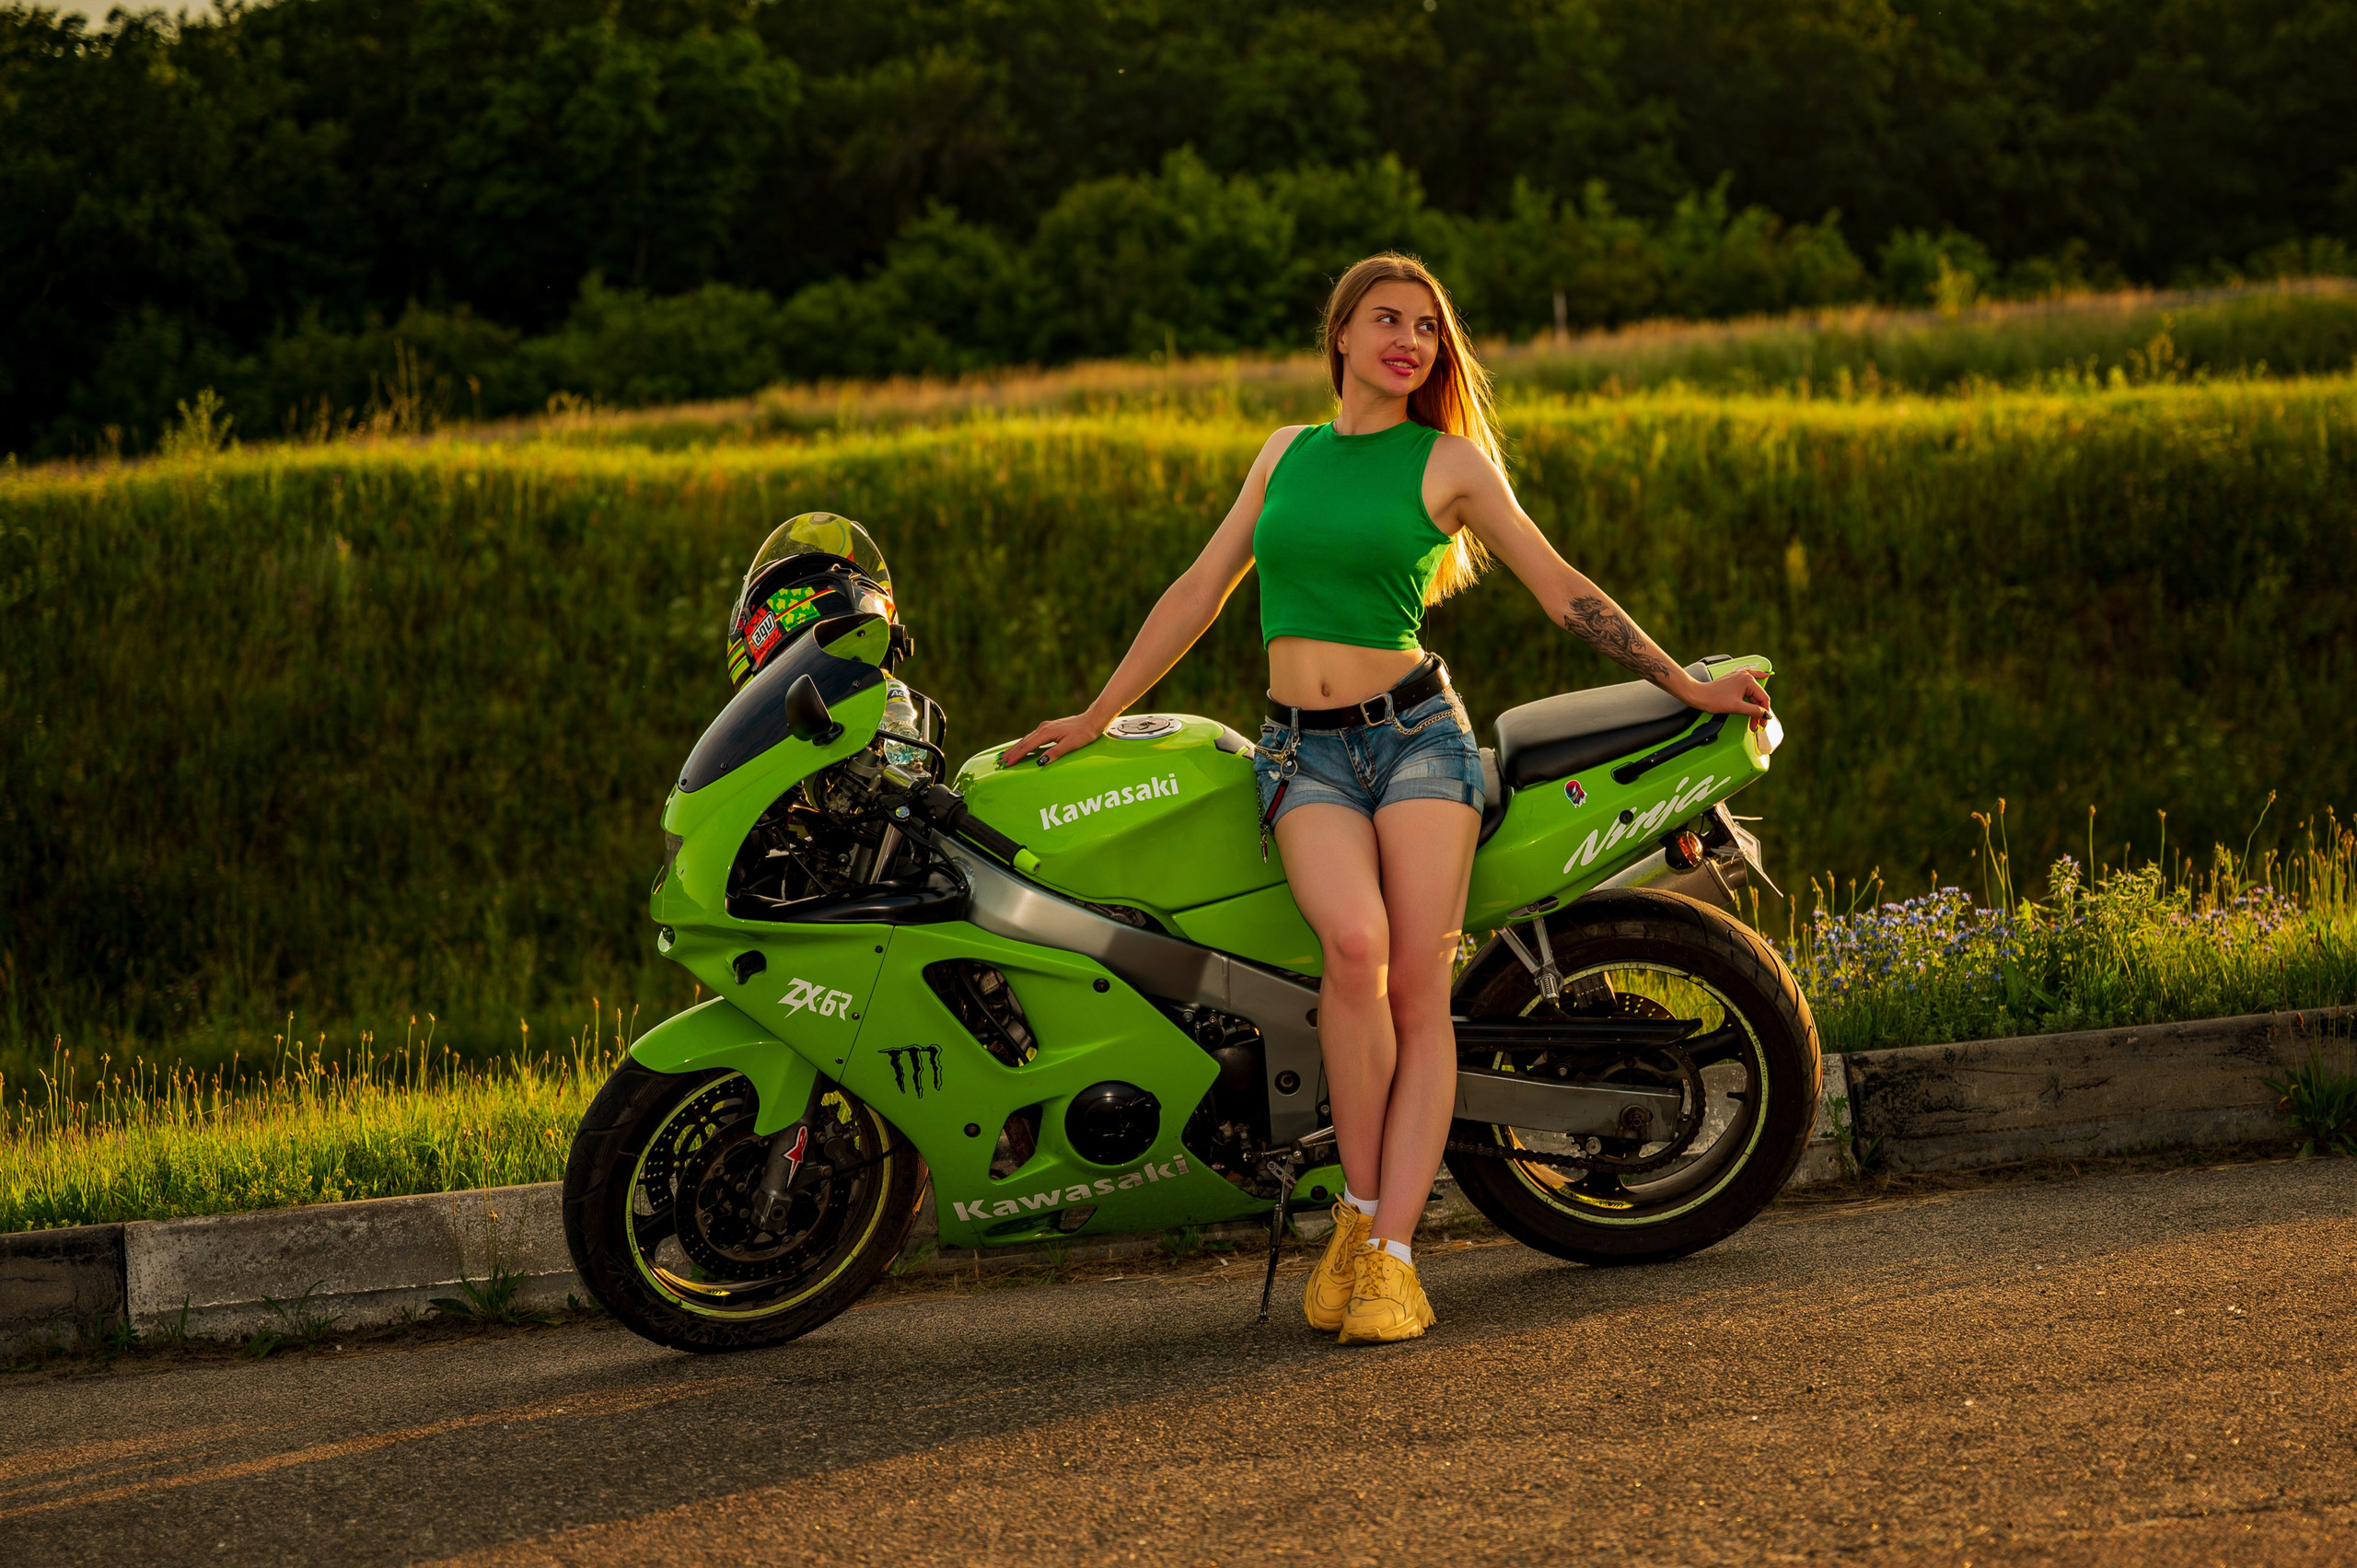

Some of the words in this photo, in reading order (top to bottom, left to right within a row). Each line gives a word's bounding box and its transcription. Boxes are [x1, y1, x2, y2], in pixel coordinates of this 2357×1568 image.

[1039, 772, 1180, 830] Kawasaki
[1562, 774, 1732, 875] Ninja
[952, 1153, 1190, 1222] Kawasaki
